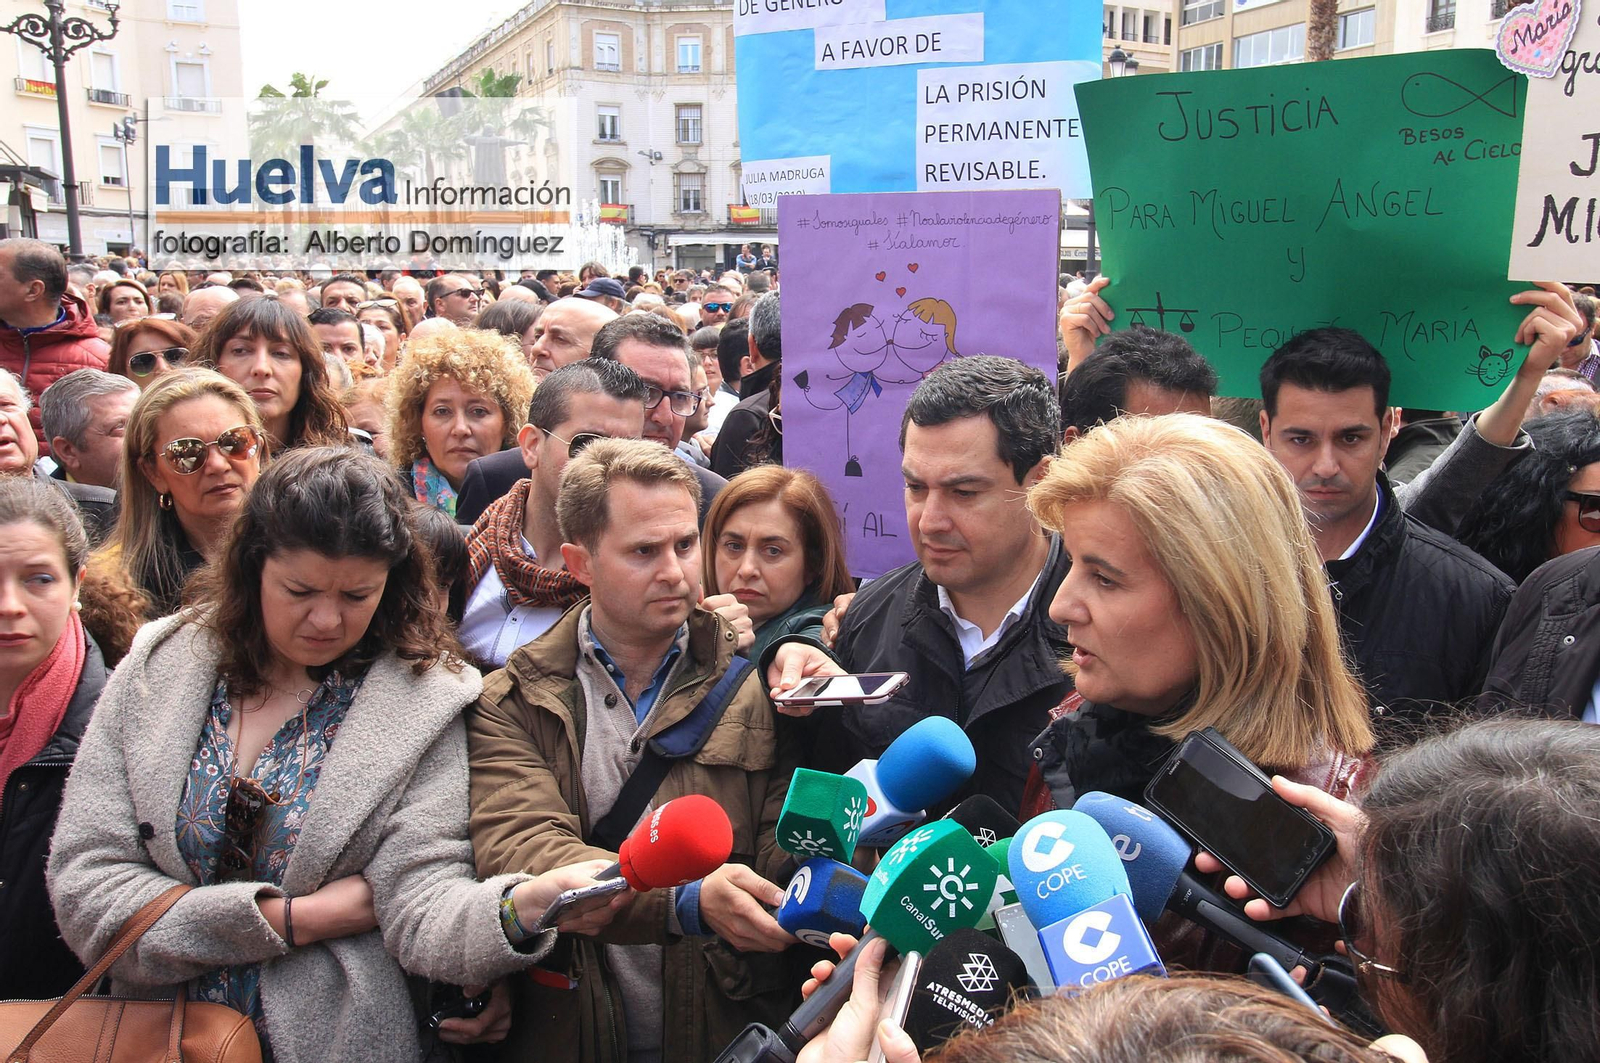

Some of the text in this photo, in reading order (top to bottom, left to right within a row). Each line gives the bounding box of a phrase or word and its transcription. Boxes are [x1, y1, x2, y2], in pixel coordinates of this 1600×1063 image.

[739, 0, 759, 16] DE
[821, 32, 942, 62] A FAVOR DE
[925, 75, 1046, 104] LA PRISIÓN
[925, 118, 1079, 143] PERMANENTE
[1399, 127, 1465, 146] BESOS
[925, 160, 1046, 183] REVISABLE.
[1432, 149, 1456, 166] AL
[746, 167, 825, 184] JULIA MADRUGA
[1100, 187, 1176, 230] PARA
[1314, 178, 1444, 233] ANGEL
[1527, 194, 1600, 247] MI
[862, 511, 898, 538] AL
[1037, 863, 1088, 900] COPE
[900, 895, 945, 941] CanalSur
[1080, 955, 1133, 989] COPE
[926, 981, 995, 1027] ATRESMEDIA
[932, 993, 983, 1029] TELEVISIÓN
